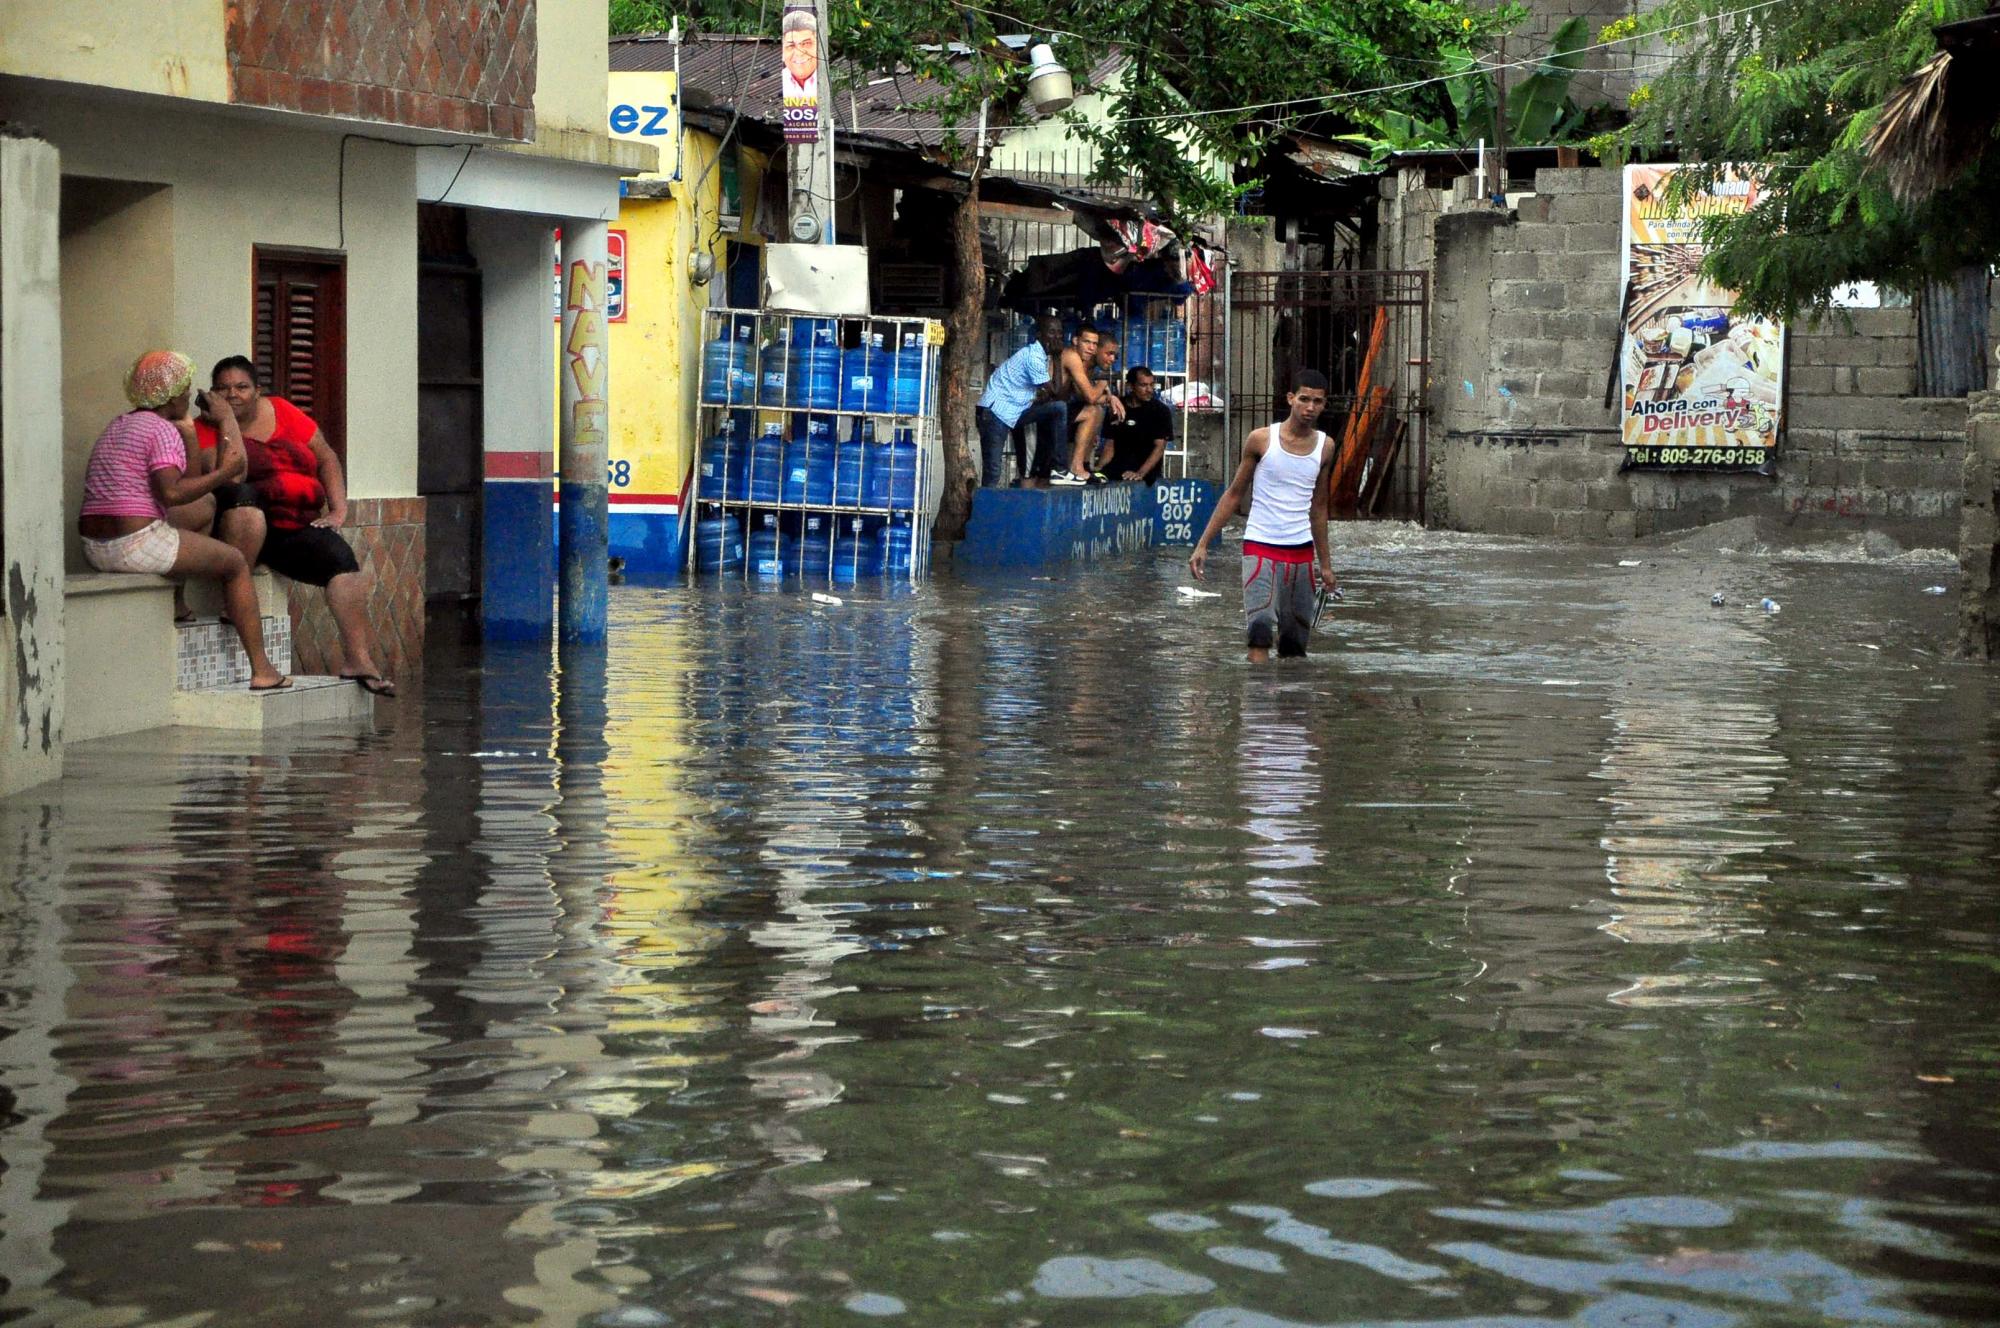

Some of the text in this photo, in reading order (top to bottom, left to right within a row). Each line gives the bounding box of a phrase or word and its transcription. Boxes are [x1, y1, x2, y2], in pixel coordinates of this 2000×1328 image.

[567, 259, 608, 445] NAVE
[1631, 399, 1717, 416] Ahora con
[1644, 408, 1740, 433] Delivery
[1660, 449, 1766, 465] 809-276-9158
[1082, 486, 1131, 520] BIENVENIDOS
[1162, 504, 1193, 521] 809
[1165, 523, 1192, 540] 276
